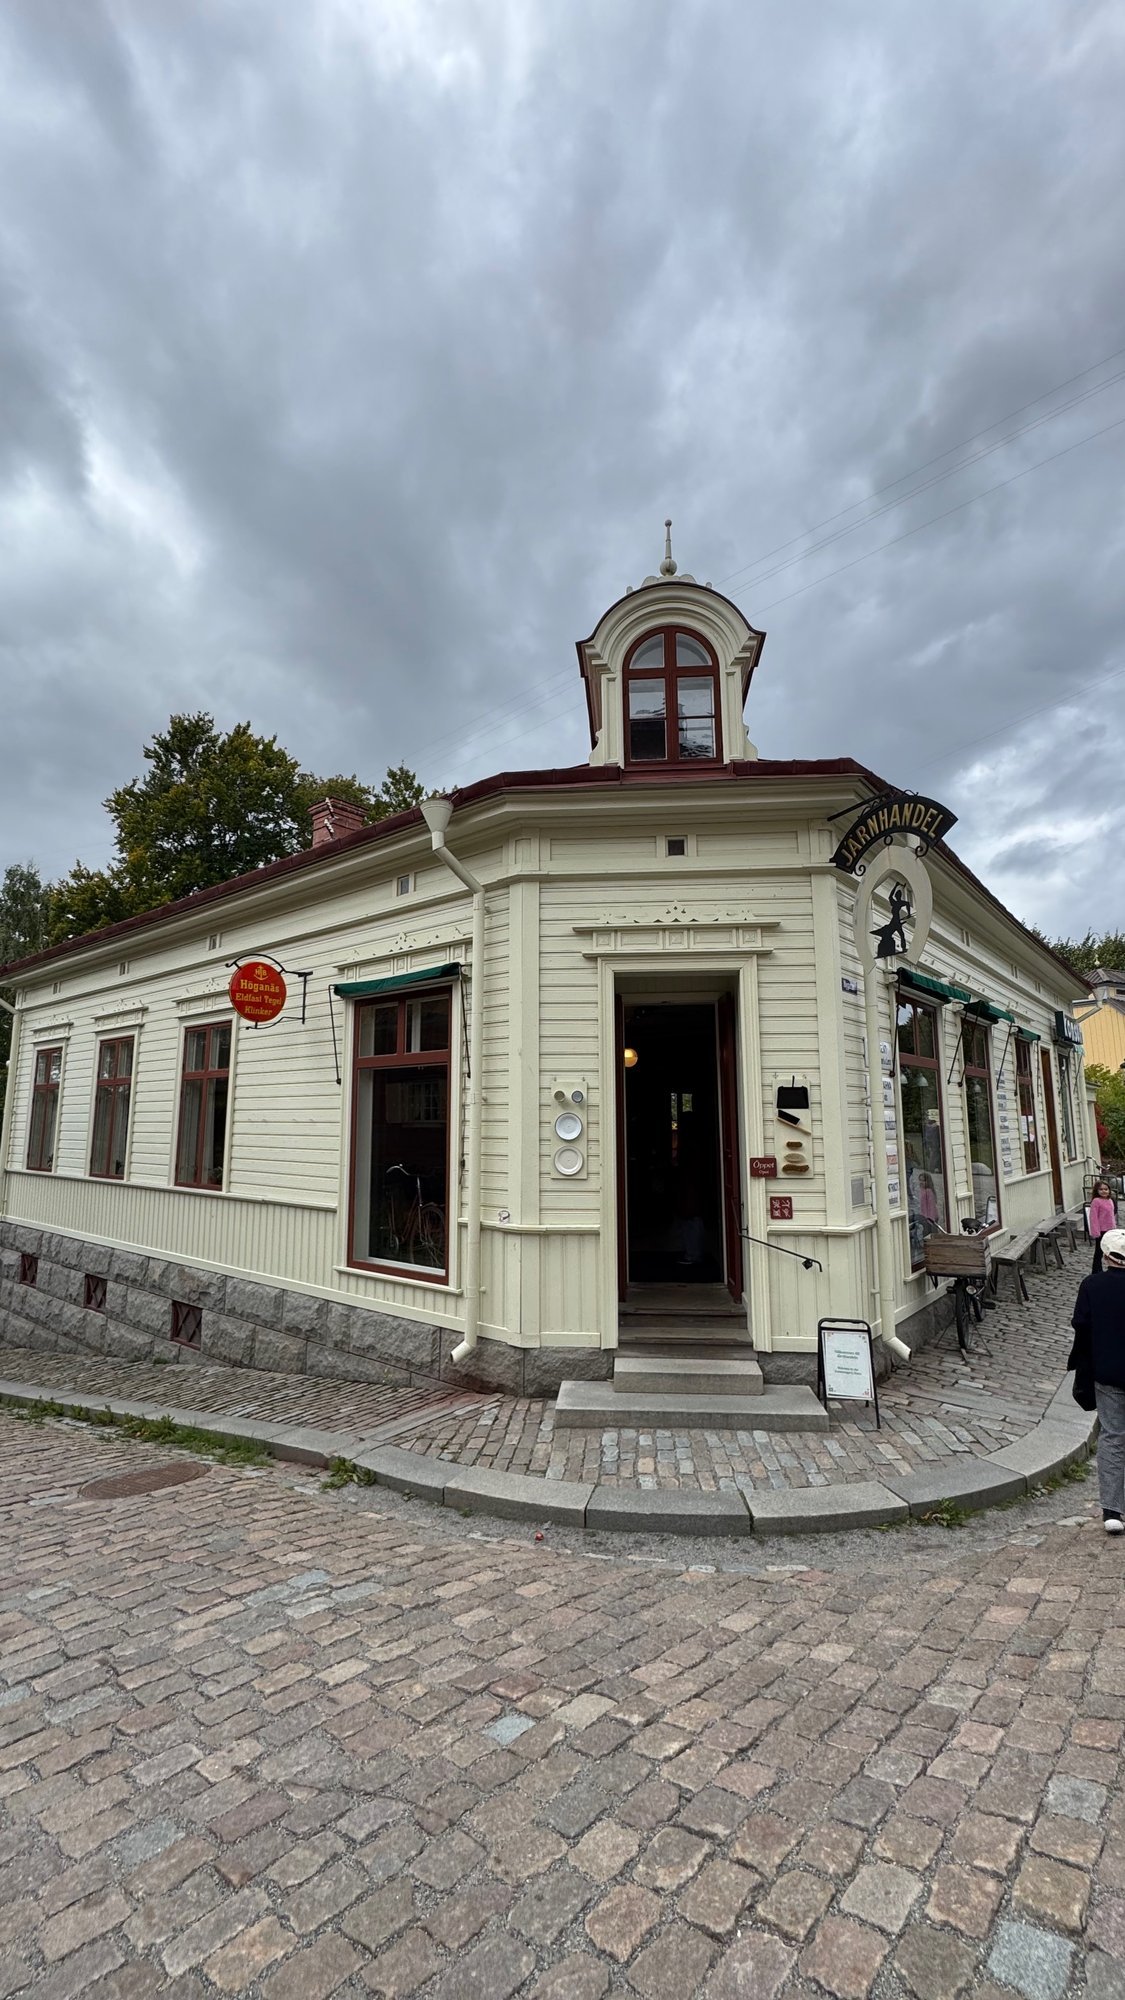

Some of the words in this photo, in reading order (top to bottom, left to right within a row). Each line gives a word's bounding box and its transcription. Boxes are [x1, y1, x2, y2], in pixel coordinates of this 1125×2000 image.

[841, 803, 943, 866] JÄRNHANDEL
[240, 979, 279, 992] Höganäs
[236, 993, 261, 1002] Eldfast
[264, 995, 281, 1005] Tegel
[245, 1005, 272, 1015] Klinker
[753, 1160, 775, 1169] Öppet
